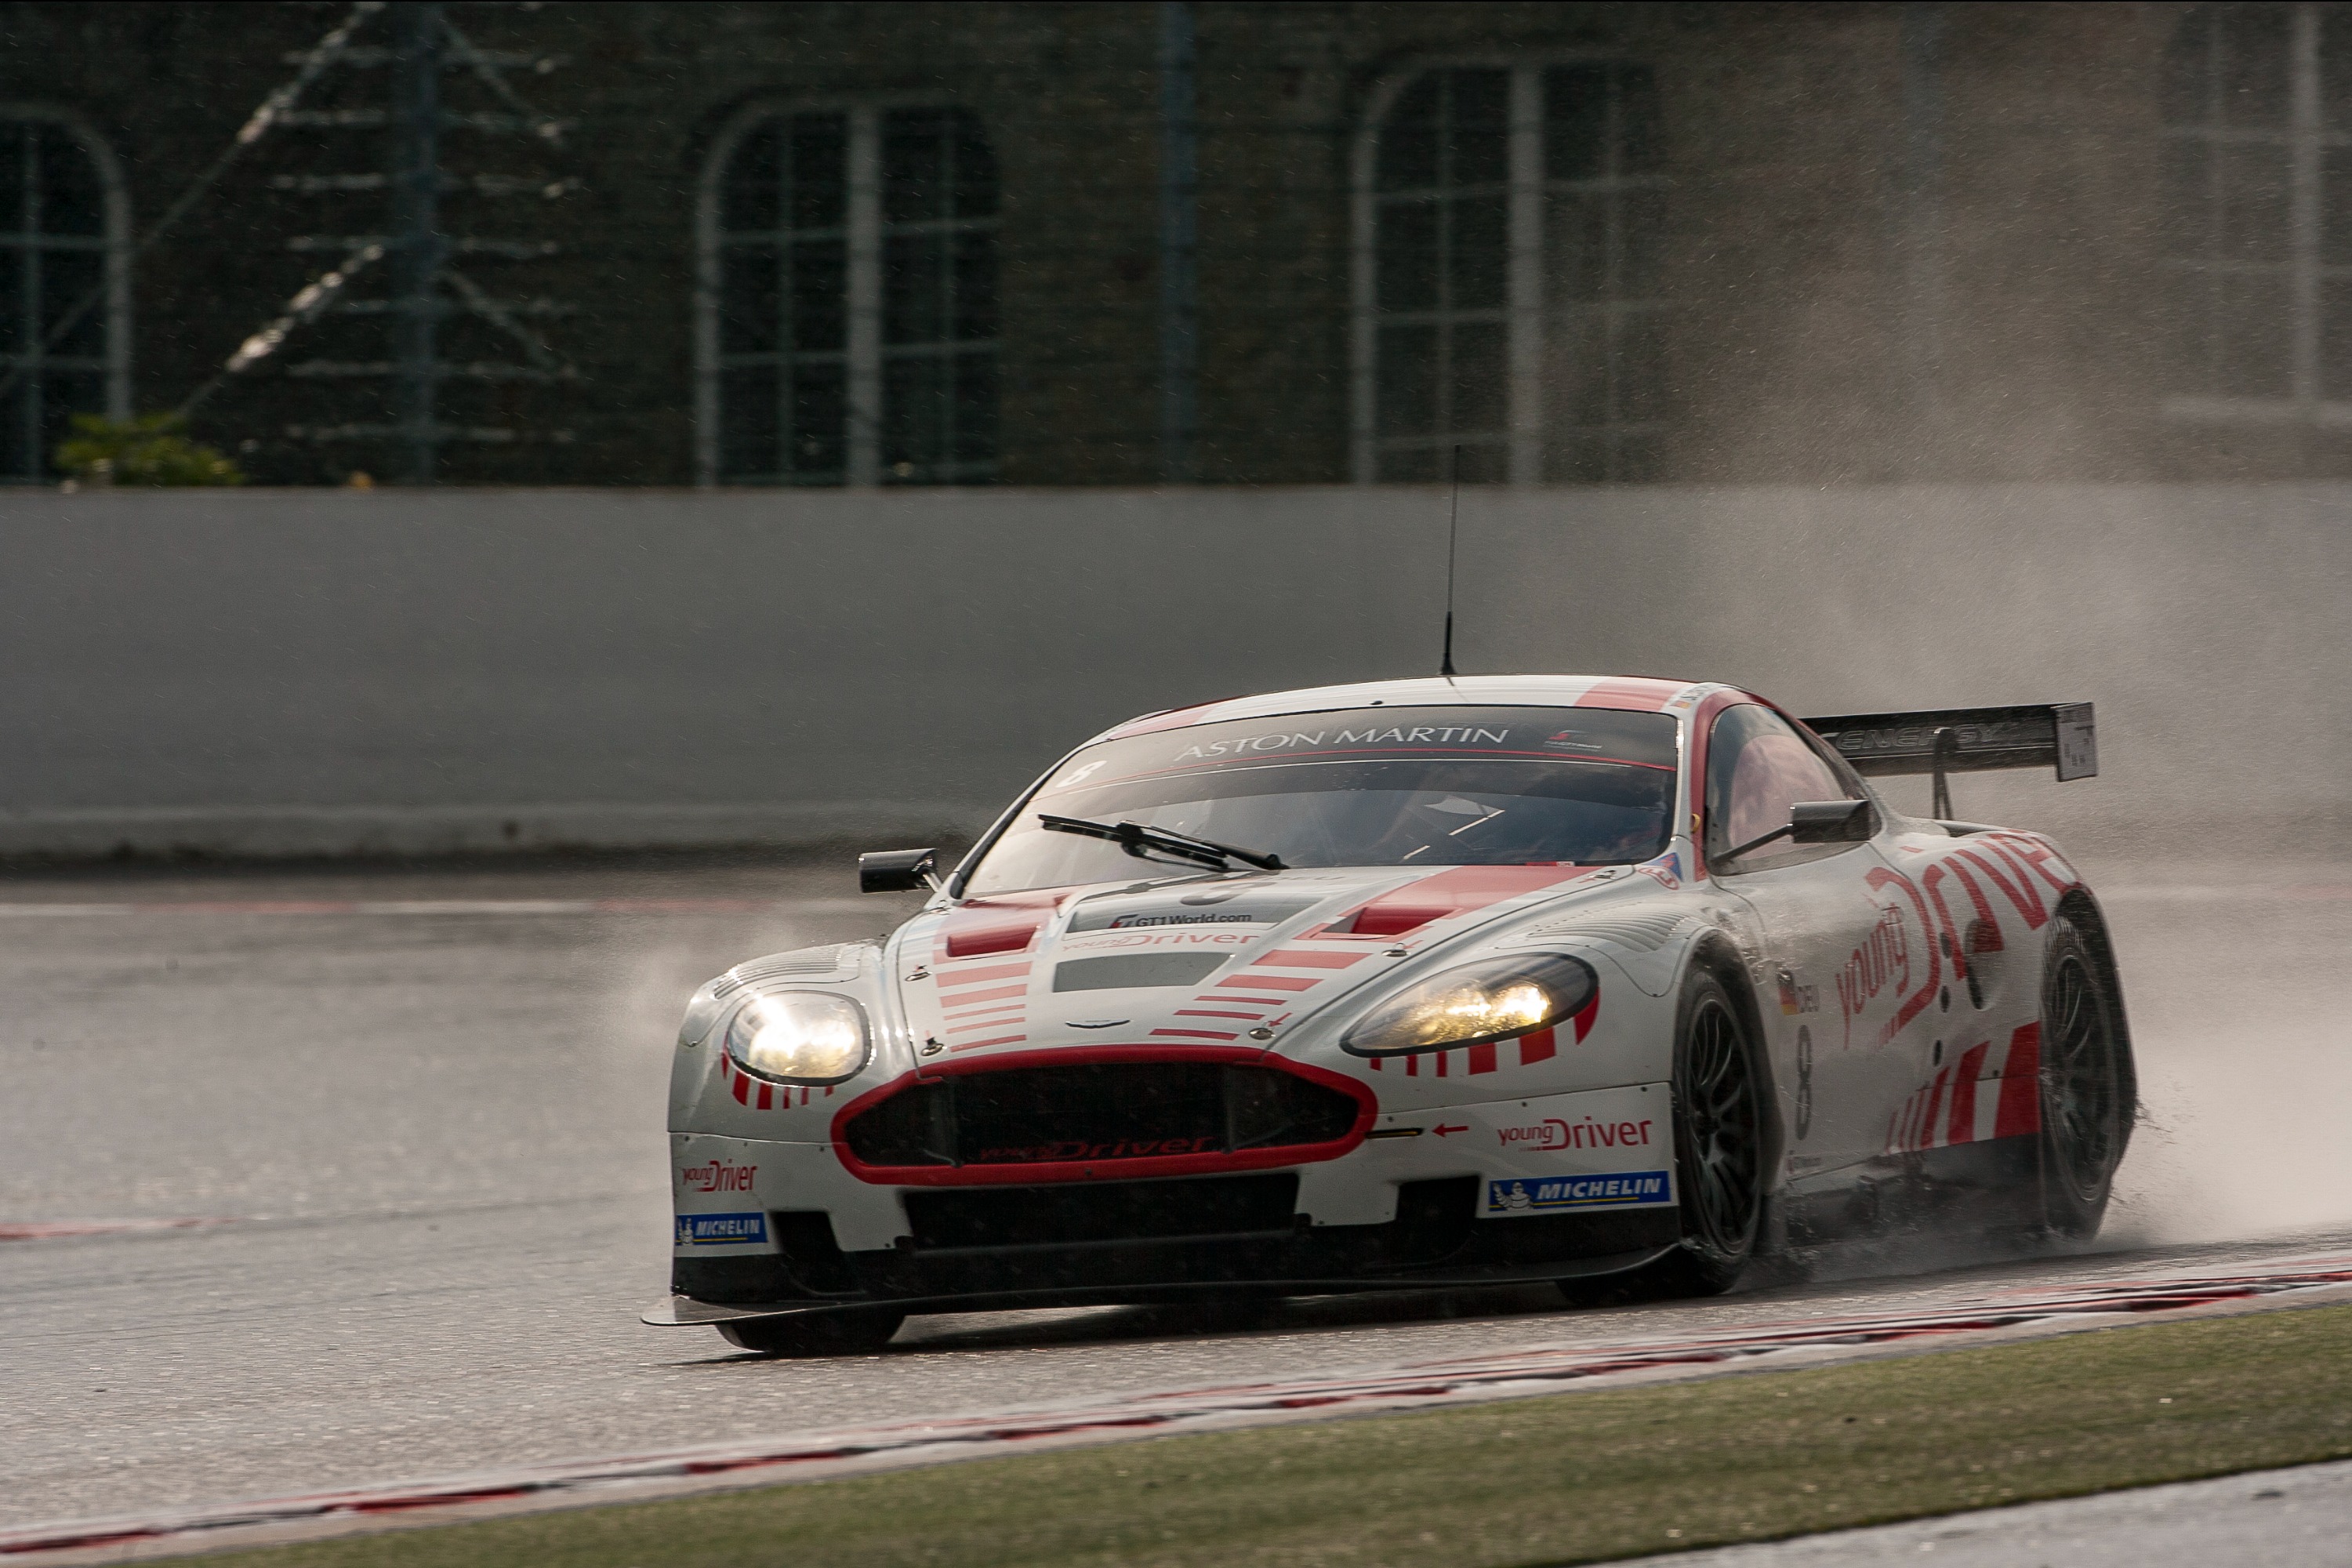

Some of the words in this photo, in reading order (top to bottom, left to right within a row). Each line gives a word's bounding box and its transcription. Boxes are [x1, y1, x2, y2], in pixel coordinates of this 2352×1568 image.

[1173, 729, 1325, 761] ASTON
[1333, 727, 1509, 745] MARTIN
[1055, 760, 1107, 788] 8
[1795, 1024, 1812, 1141] 8
[1536, 1178, 1663, 1200] MICHELIN
[695, 1219, 760, 1236] MICHELIN
